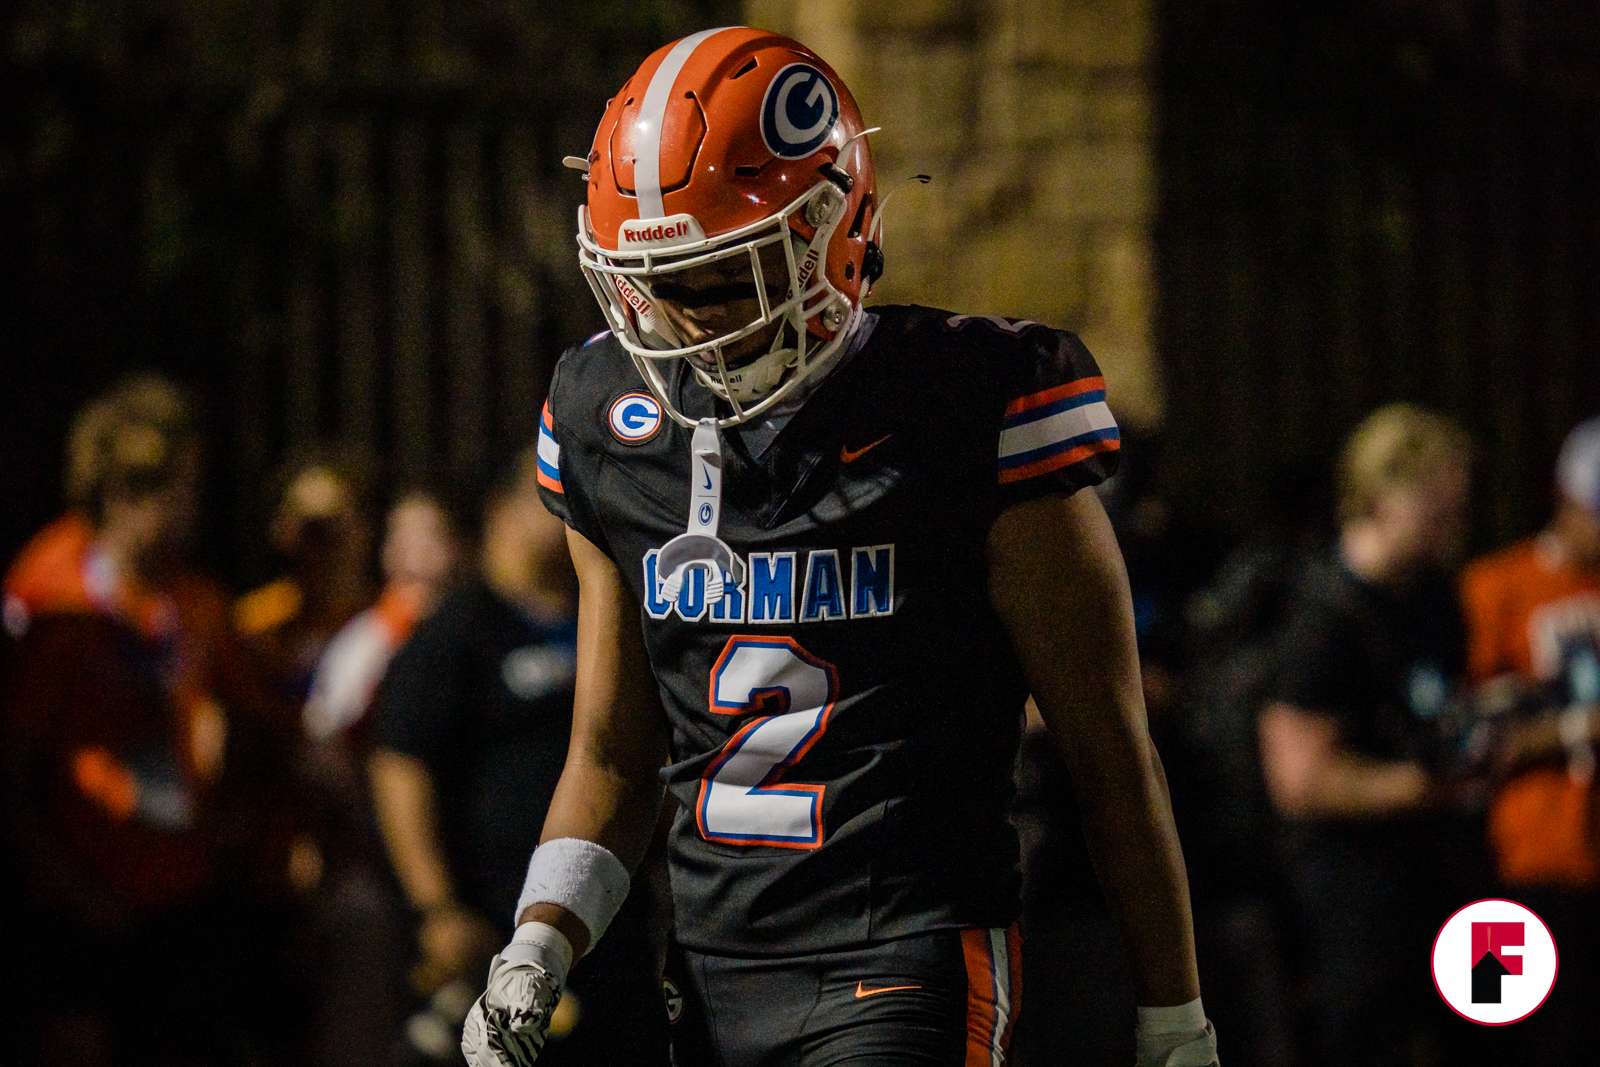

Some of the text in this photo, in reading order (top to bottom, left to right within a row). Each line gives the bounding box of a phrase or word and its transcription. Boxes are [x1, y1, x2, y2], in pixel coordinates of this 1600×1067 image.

[775, 72, 833, 145] G
[624, 221, 688, 242] Riddell
[613, 397, 659, 437] G
[643, 543, 895, 624] GORMAN
[696, 635, 840, 850] 2
